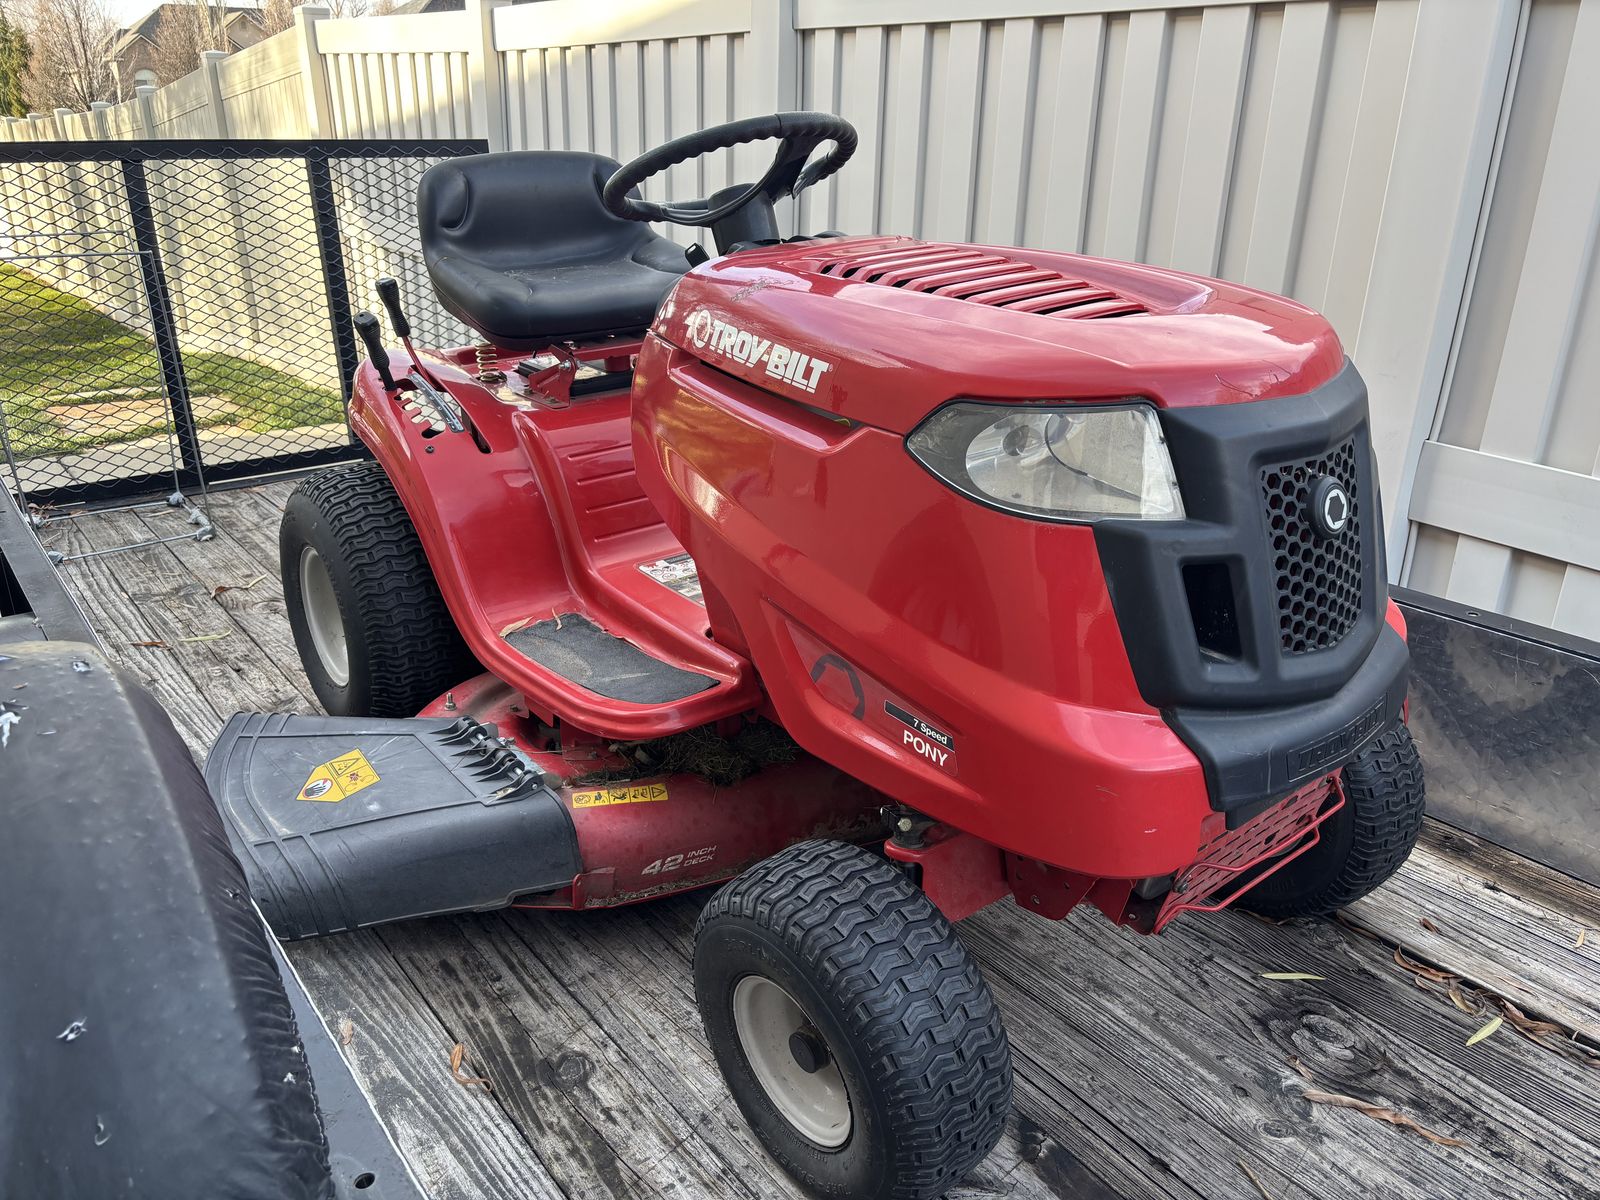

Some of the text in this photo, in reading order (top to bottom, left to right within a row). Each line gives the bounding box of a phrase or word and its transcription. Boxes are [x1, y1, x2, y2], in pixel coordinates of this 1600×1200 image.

[709, 319, 831, 395] TROY-BILT
[913, 718, 948, 745] 7 Speed
[903, 729, 949, 767] PONY
[641, 845, 717, 875] 42 INCH
[683, 854, 715, 867] DECK
